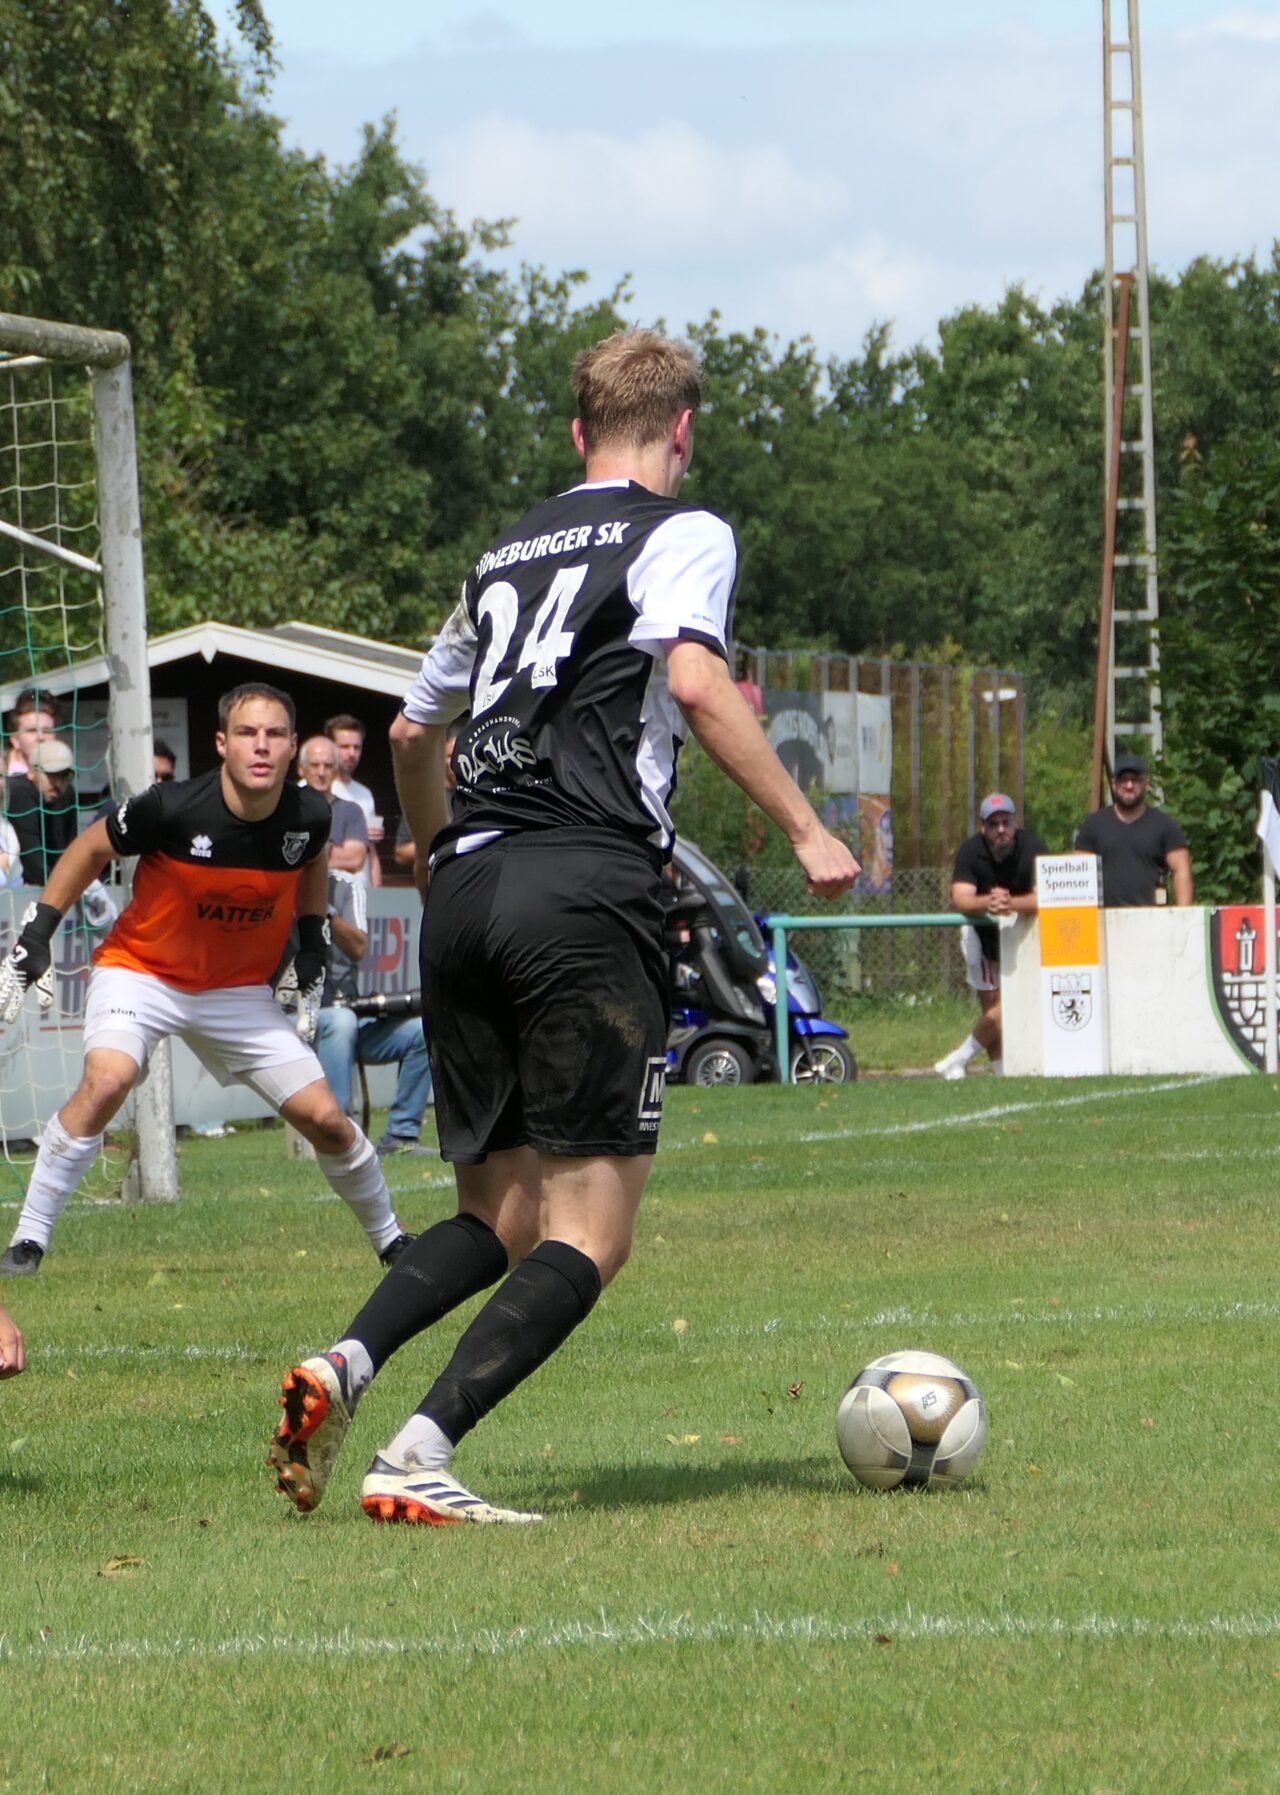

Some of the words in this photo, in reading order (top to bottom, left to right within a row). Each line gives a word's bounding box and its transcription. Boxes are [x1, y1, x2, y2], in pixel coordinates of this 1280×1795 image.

[594, 522, 631, 546] SK
[474, 564, 589, 720] 24
[457, 731, 537, 784] DACHS
[1045, 878, 1090, 892] Sponsor
